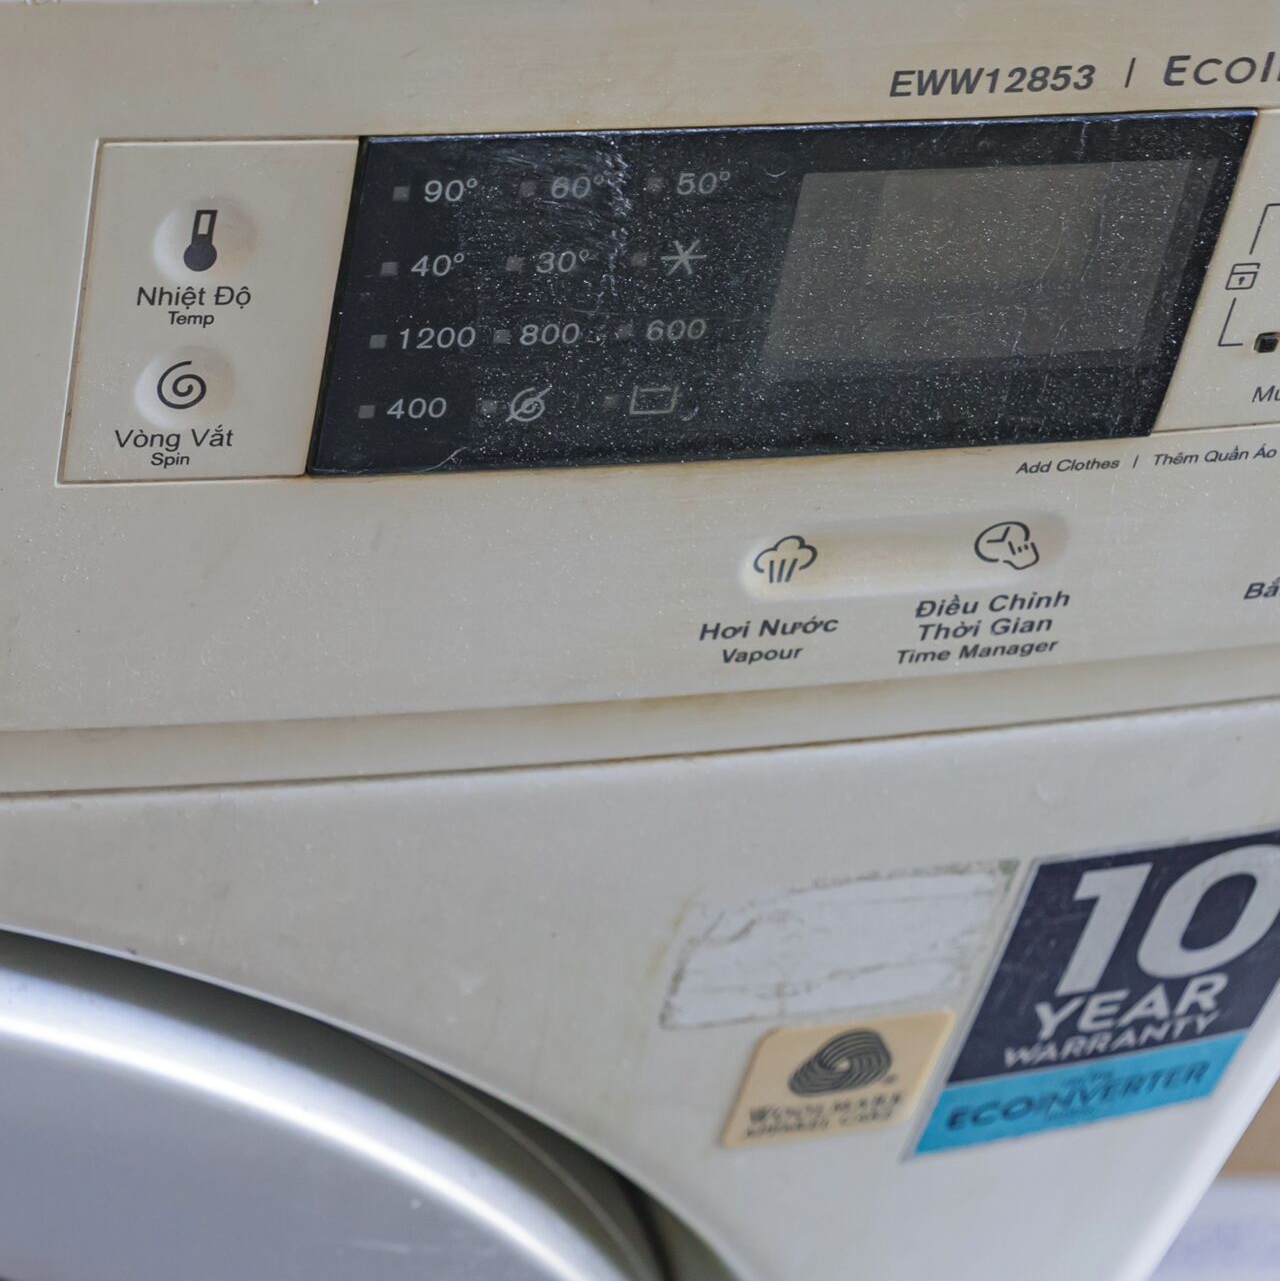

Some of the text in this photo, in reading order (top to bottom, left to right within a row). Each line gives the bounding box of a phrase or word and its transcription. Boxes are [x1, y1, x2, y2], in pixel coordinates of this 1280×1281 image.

[889, 64, 1096, 98] EWW12853
[136, 285, 252, 310] Nhiệt Độ
[167, 310, 215, 329] Temp
[645, 318, 708, 342] 600
[398, 326, 477, 350] 1200
[519, 322, 581, 347] 800
[385, 396, 448, 420] 400
[114, 424, 234, 455] Vòng Vắt
[150, 448, 190, 470] Spin
[1015, 460, 1053, 475] Add
[1056, 457, 1120, 472] Clothes
[1154, 452, 1200, 466] Thêm
[1252, 442, 1278, 459] Áo
[915, 594, 979, 618] Điều
[699, 616, 839, 641] Hơi Nước
[919, 617, 1053, 642] Thời Gian
[722, 647, 803, 665] Vapour
[897, 640, 1059, 665] Time Manager
[1054, 844, 1280, 998] 10
[1034, 972, 1229, 1041] YEAR
[1004, 1011, 1221, 1068] WARRANTY
